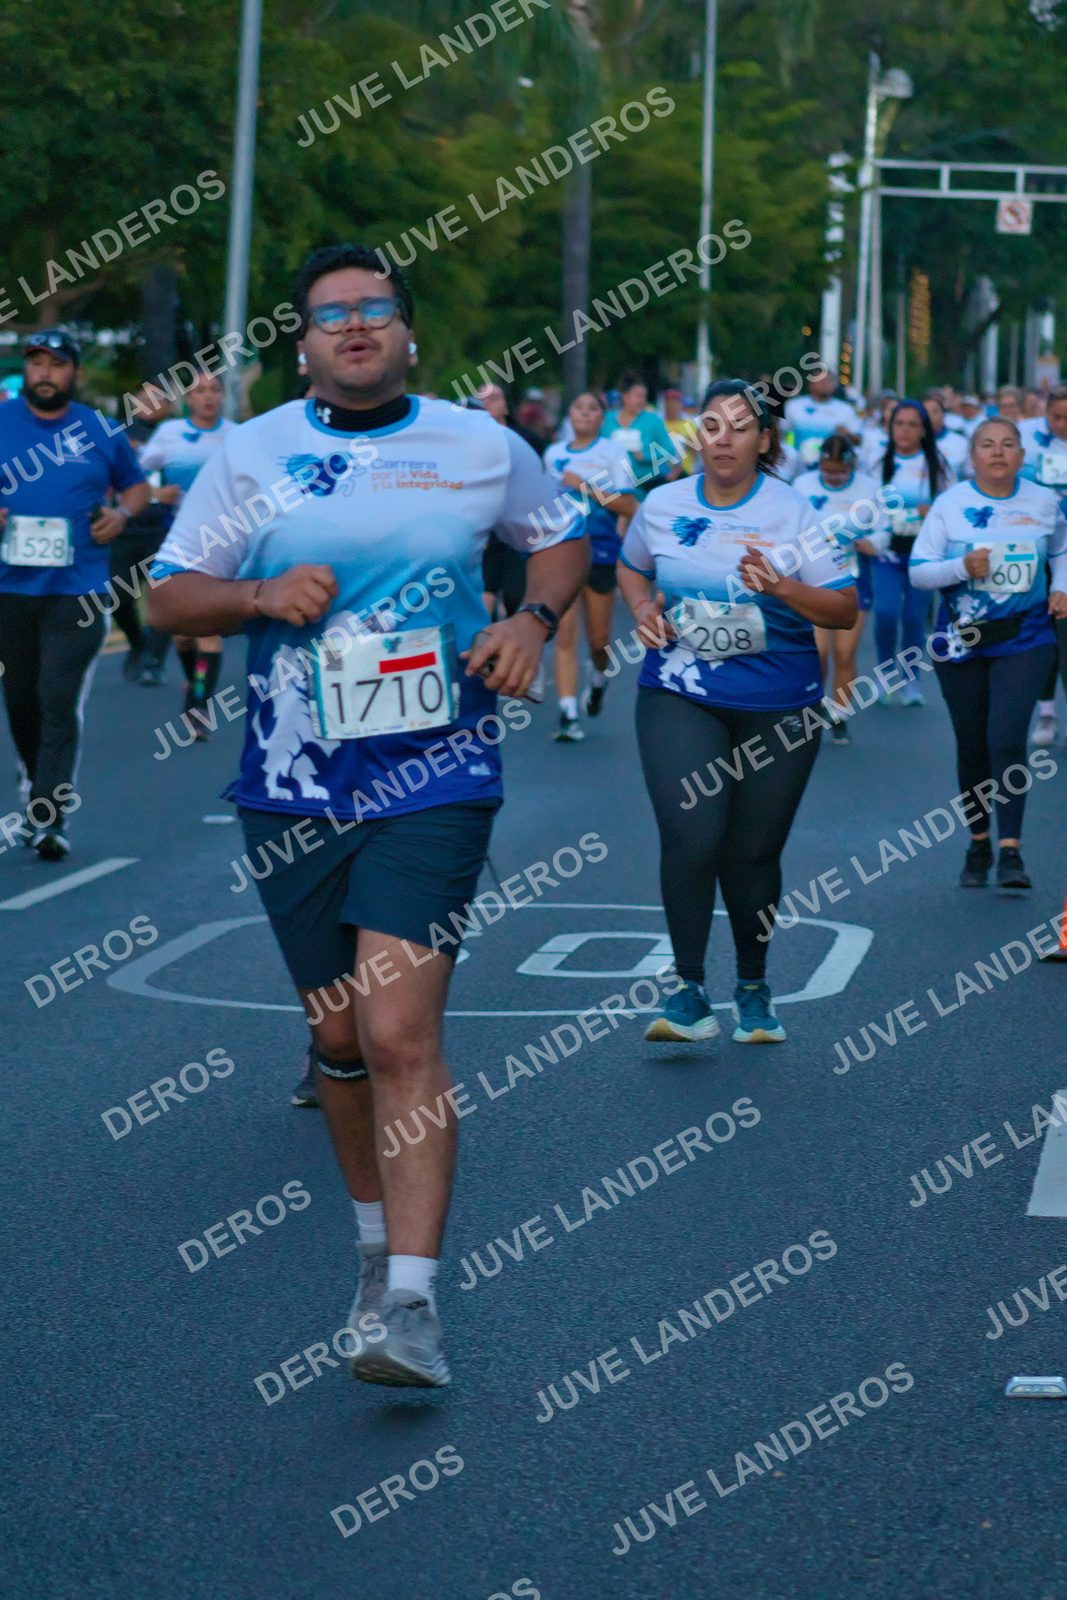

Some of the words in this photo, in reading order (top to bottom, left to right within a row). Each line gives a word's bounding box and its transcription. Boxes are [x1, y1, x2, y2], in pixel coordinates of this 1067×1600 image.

[371, 458, 437, 469] Carrera
[410, 470, 438, 479] Vida
[693, 626, 752, 652] 208
[330, 670, 444, 725] 1710
